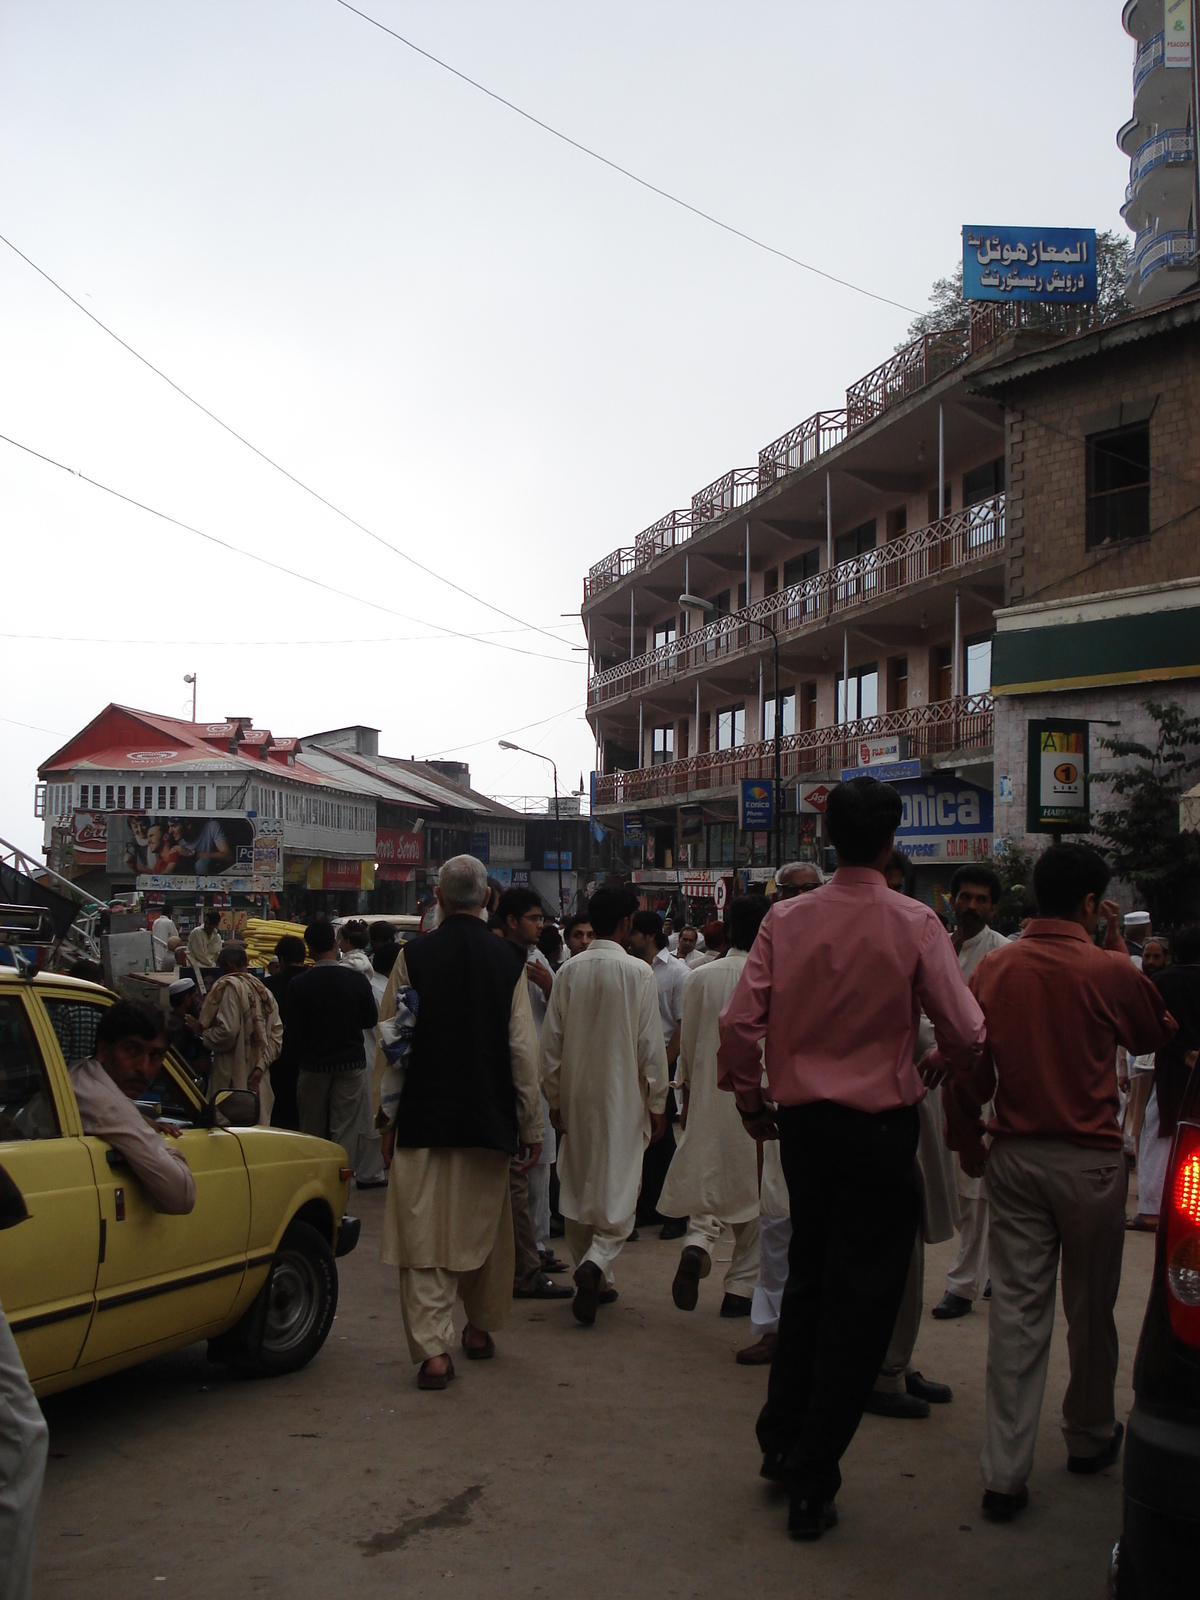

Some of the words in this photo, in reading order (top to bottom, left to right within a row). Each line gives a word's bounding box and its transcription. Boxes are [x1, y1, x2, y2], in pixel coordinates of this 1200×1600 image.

[1174, 20, 1184, 31] &
[1061, 766, 1071, 781] 1
[745, 800, 769, 808] Konica
[807, 792, 830, 804] Agf
[896, 785, 981, 828] onica
[946, 839, 968, 856] COLOR
[973, 838, 988, 856] LAB
